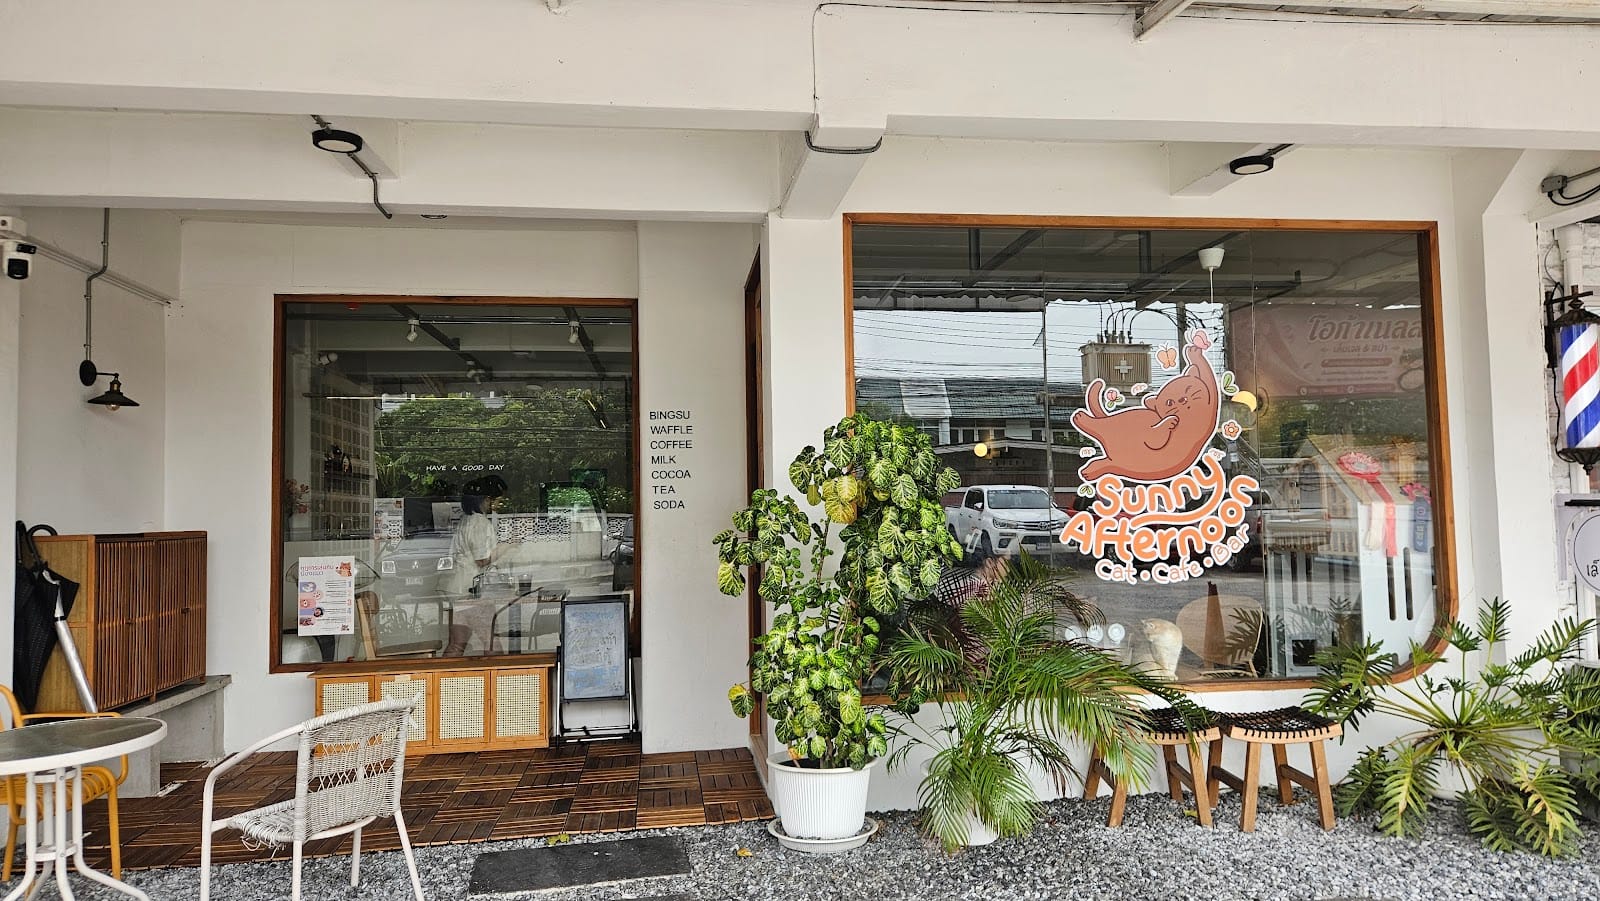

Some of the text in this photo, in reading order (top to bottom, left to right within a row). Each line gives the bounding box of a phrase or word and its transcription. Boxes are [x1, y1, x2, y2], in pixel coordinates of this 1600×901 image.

[649, 410, 691, 420] BINGSU
[650, 425, 693, 435] WAFFLE
[650, 440, 693, 450] COFFEE
[651, 455, 677, 465] MILK
[651, 469, 691, 479] COCOA
[652, 485, 676, 495] TEA
[1092, 453, 1226, 529] Sunny
[653, 500, 685, 510] SODA
[1060, 475, 1260, 562] Afternoon
[1094, 522, 1250, 584] Cat Cafe Bar
